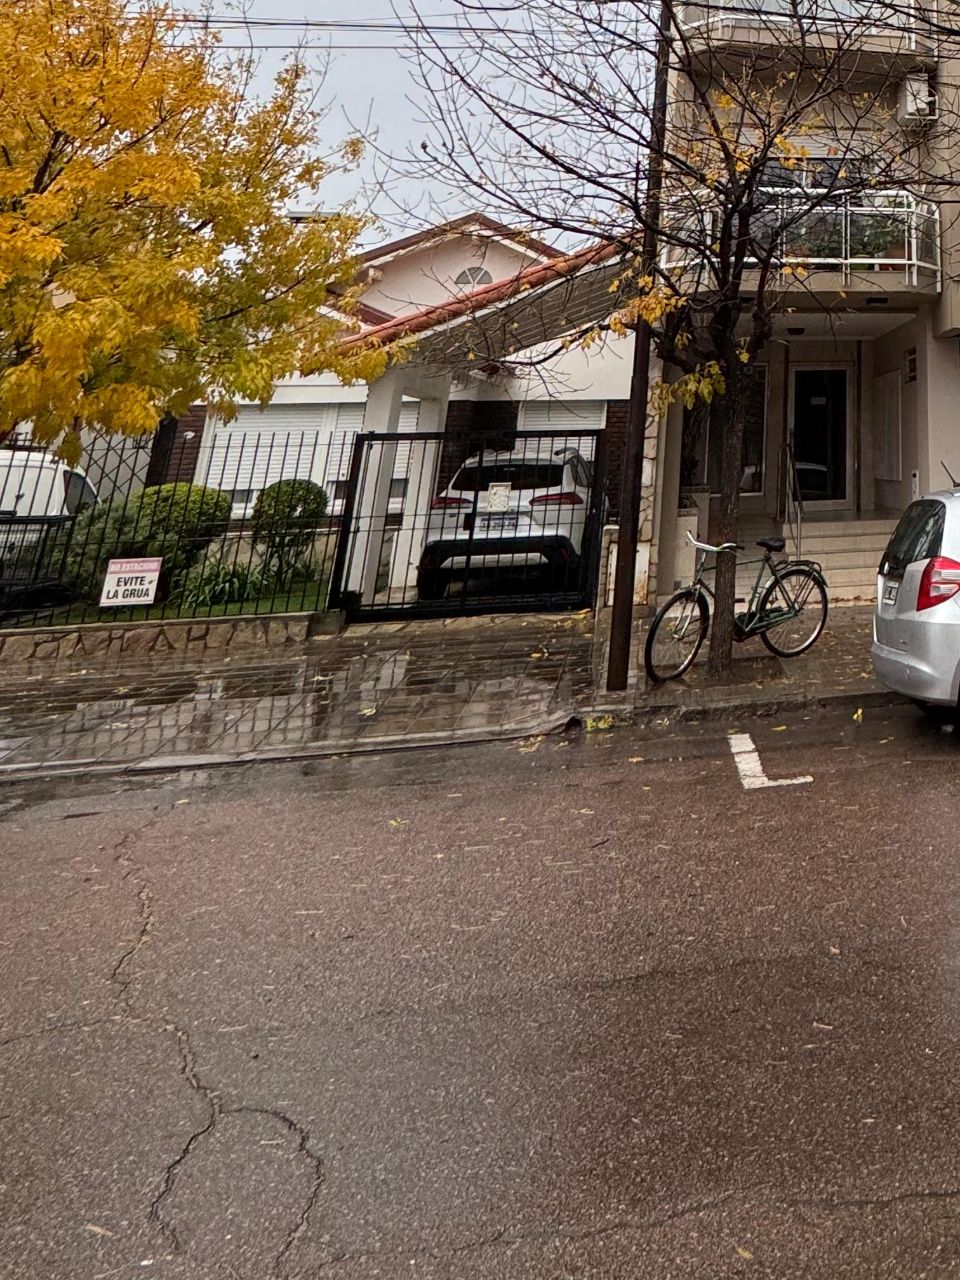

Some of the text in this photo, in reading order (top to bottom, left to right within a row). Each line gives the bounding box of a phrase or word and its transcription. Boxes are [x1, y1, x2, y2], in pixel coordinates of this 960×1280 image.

[116, 576, 146, 587] EVITE
[106, 588, 150, 600] LA GRUA
